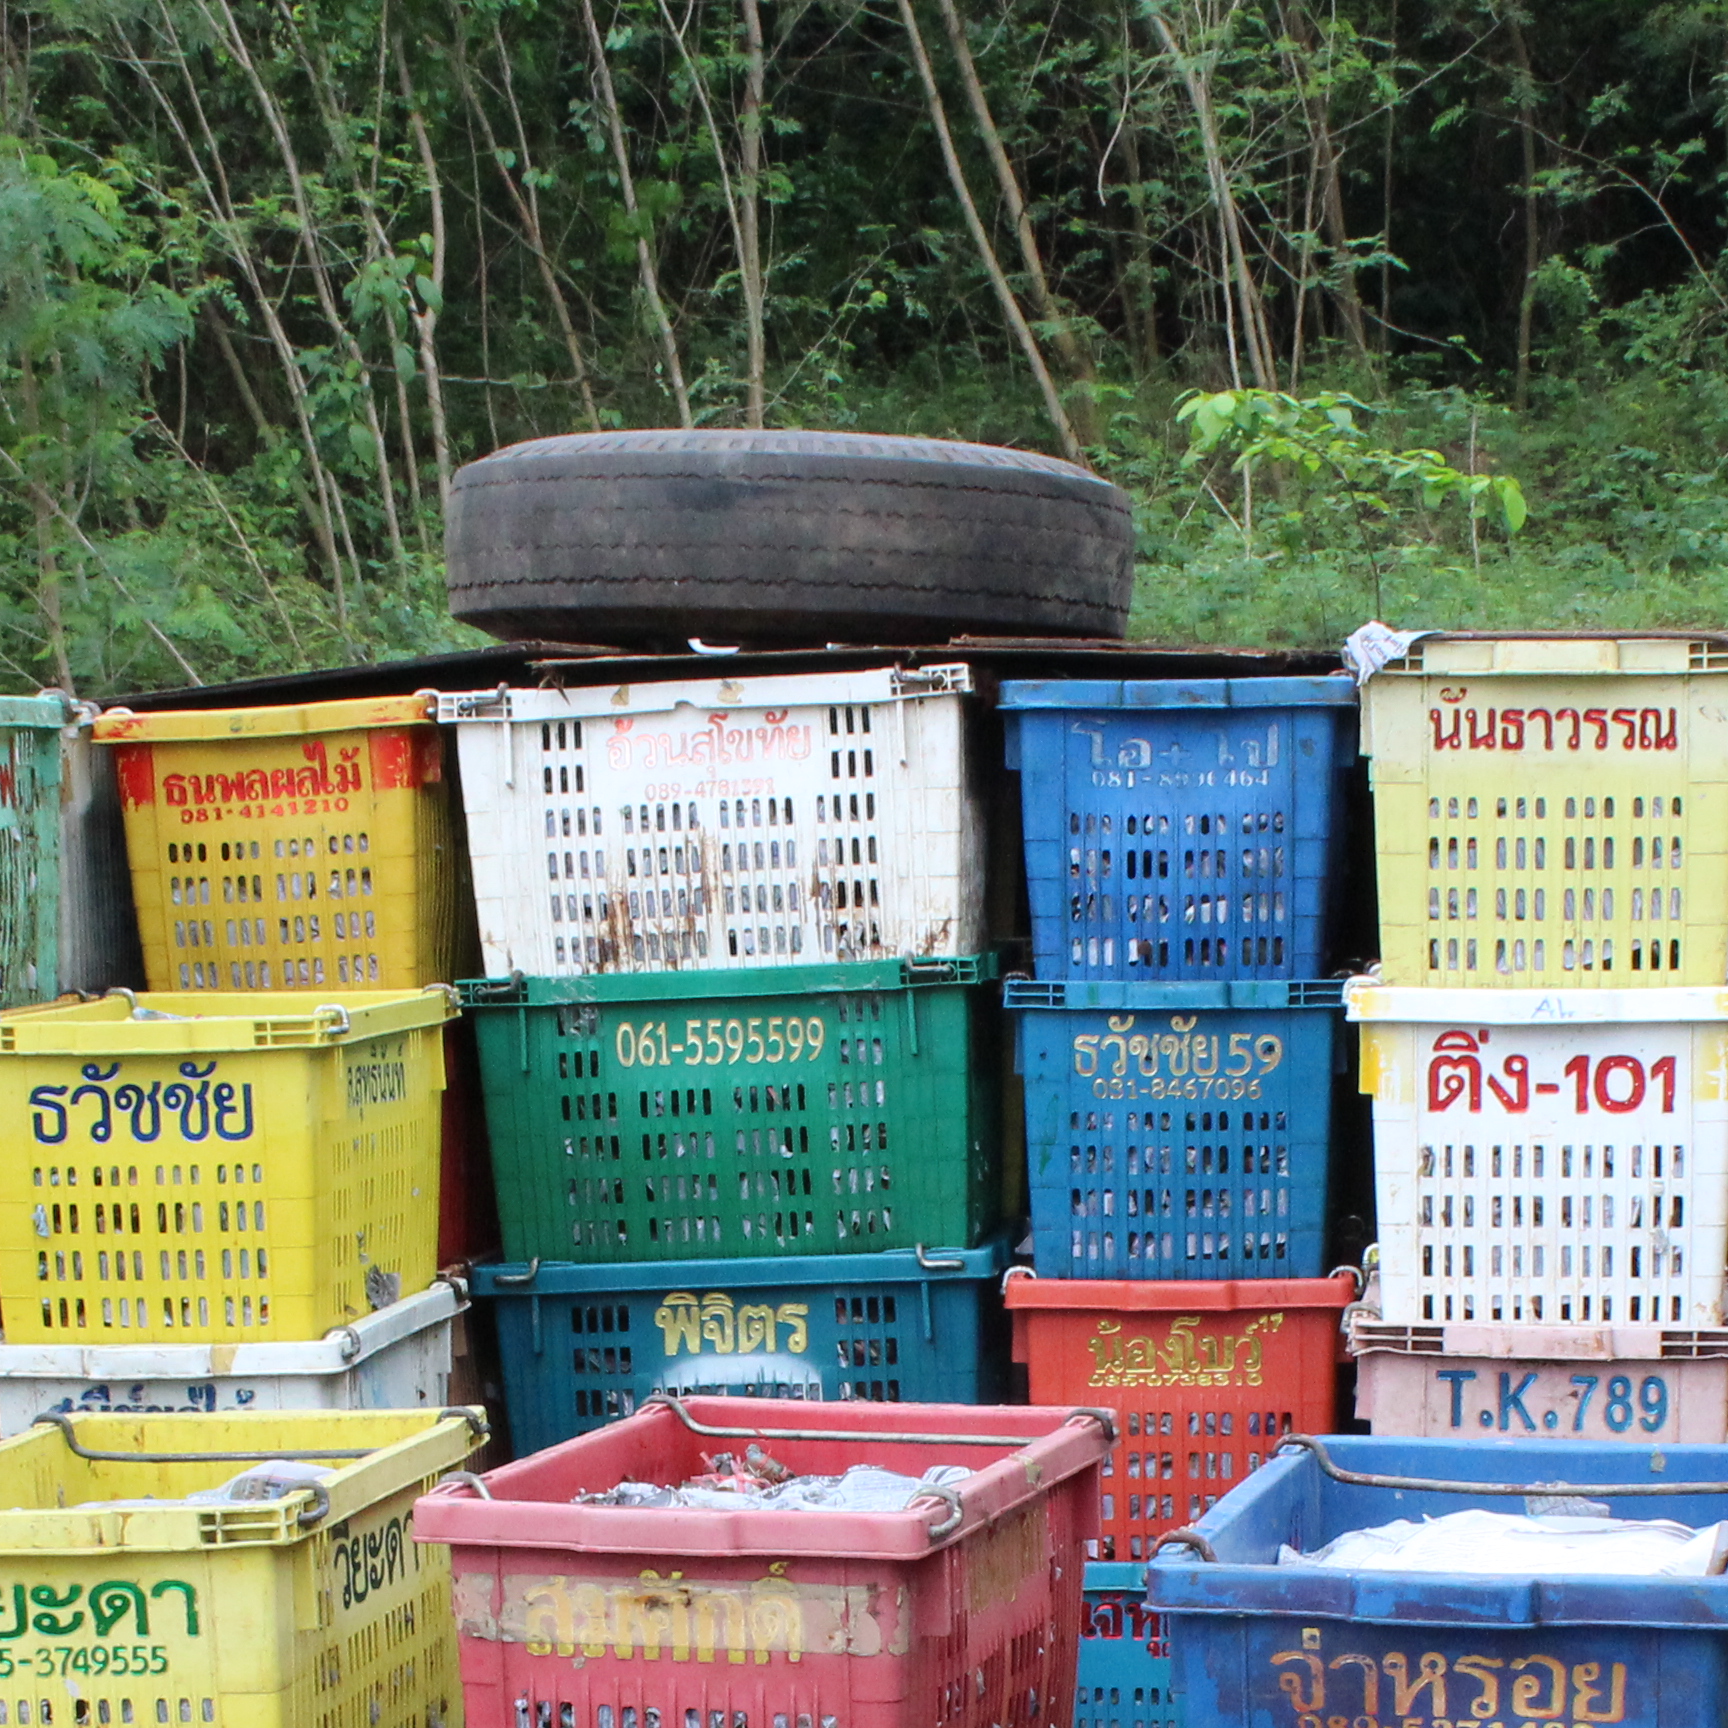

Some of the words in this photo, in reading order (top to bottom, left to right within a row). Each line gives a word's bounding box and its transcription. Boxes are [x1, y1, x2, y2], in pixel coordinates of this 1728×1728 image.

[606, 709, 813, 779] อ้วนสุโขทัย
[1430, 687, 1677, 751] นันธาวรรณ
[162, 740, 363, 807] ธนพลผลไม้
[616, 1016, 825, 1067] 061-5595599
[1428, 1029, 1677, 1114] ติ่ง-101
[29, 1060, 255, 1145] ธวัชชัย
[654, 1291, 809, 1357] พิจิตร
[1087, 1316, 1262, 1374] น้องโบว์
[1270, 1627, 1627, 1724] จ่าหรอย
